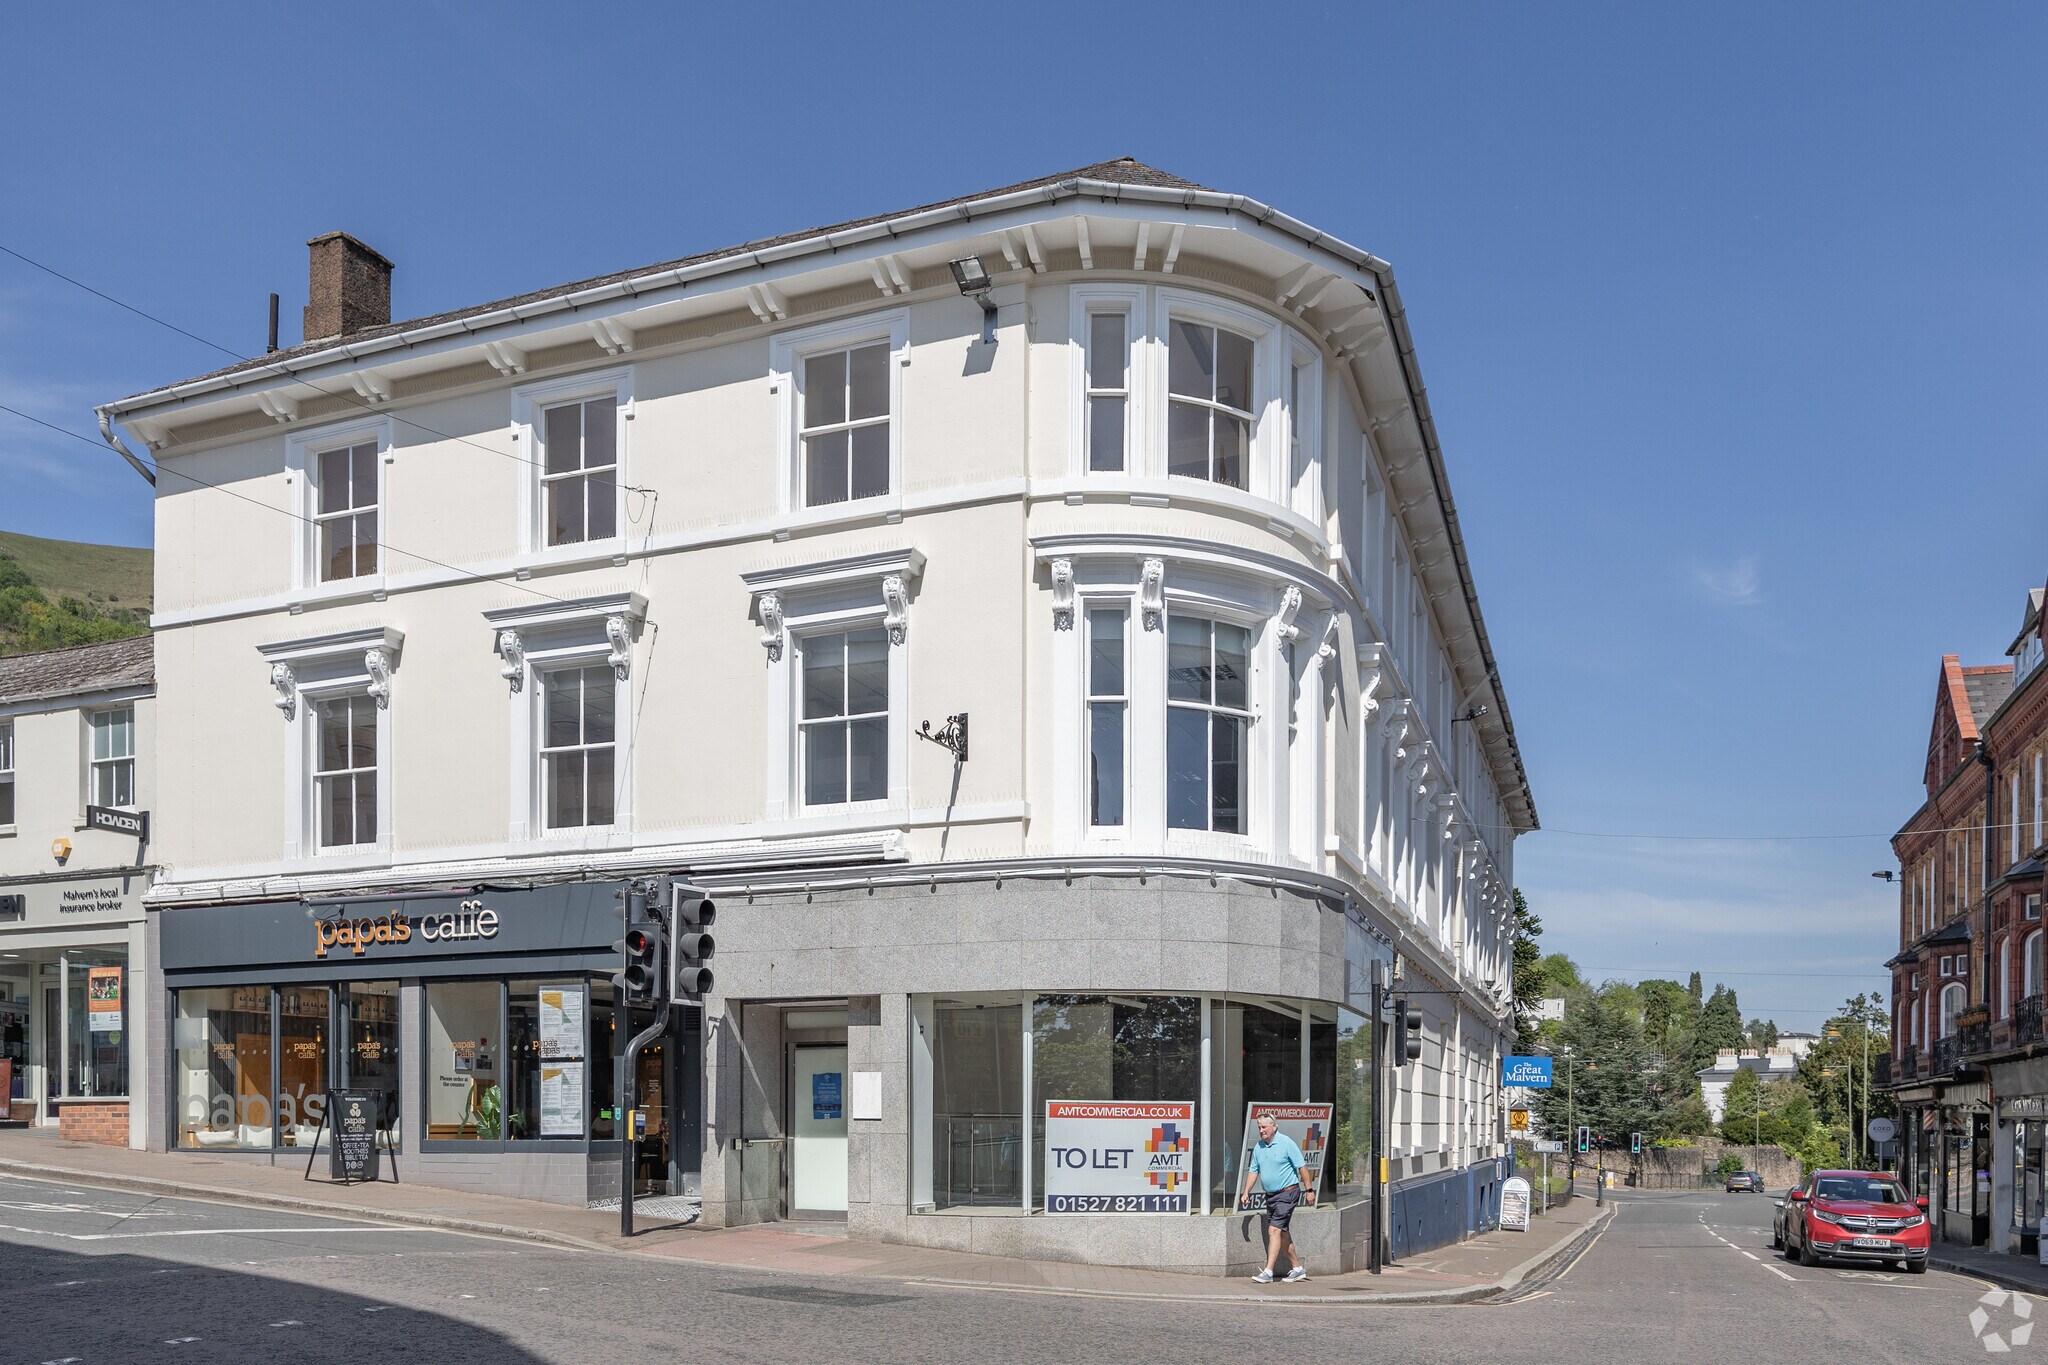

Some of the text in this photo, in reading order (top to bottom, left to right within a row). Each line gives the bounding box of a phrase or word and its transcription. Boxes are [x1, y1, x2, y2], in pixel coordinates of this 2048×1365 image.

[96, 812, 140, 831] HOWDEN
[63, 887, 119, 901] Malvern's local
[60, 900, 122, 914] insurance broker
[314, 899, 499, 955] papa's caffe
[1513, 1064, 1542, 1075] Great
[1505, 1071, 1548, 1083] Malvern
[1057, 1106, 1183, 1117] AMTCOMMERCIAL.CO.UK
[1051, 1147, 1134, 1169] TO LET
[1149, 1153, 1182, 1166] AMT
[1055, 1196, 1180, 1212] 01527 821 111
